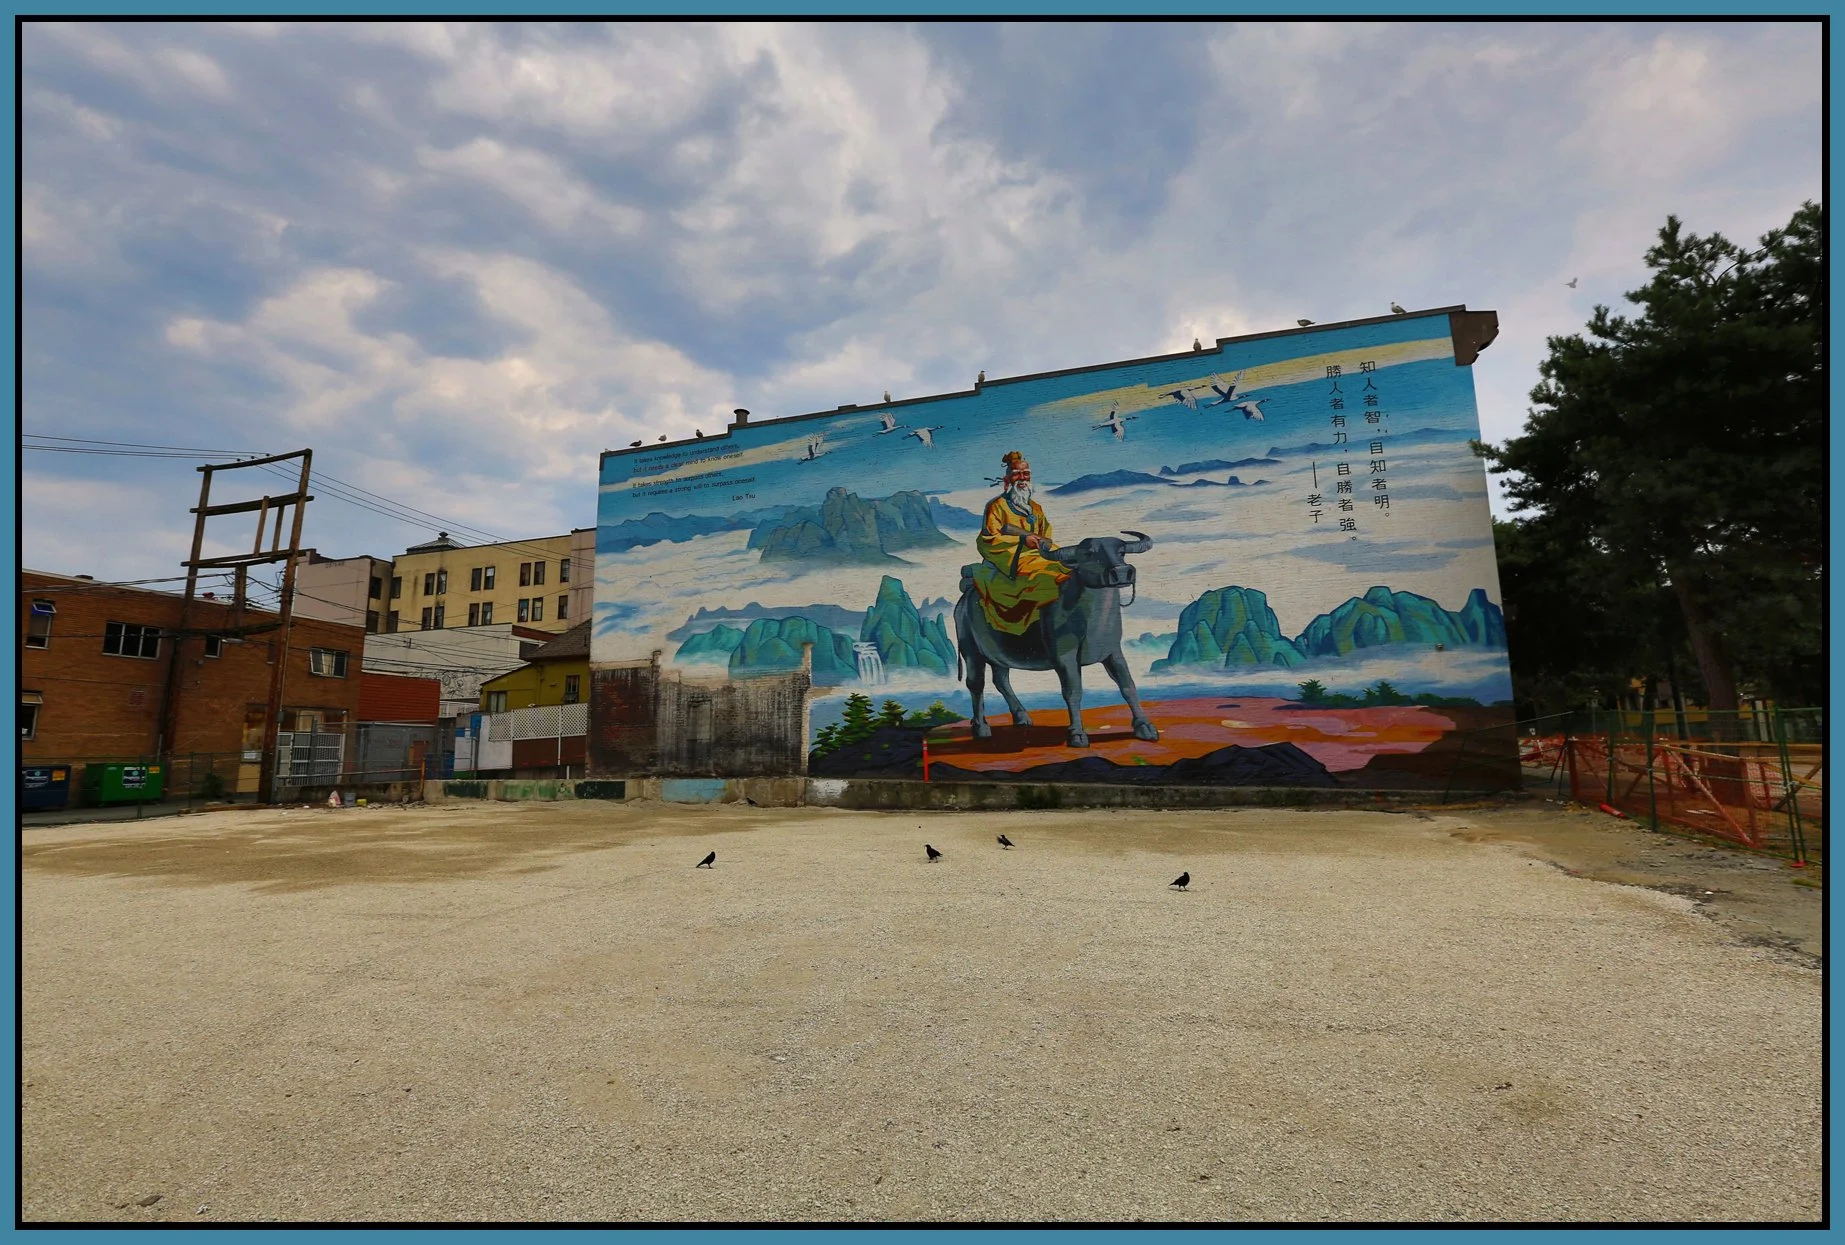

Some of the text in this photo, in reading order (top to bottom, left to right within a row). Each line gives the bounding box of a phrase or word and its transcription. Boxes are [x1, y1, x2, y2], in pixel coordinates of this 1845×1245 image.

[654, 452, 681, 461] knowledge
[690, 446, 720, 456] understand
[647, 488, 668, 496] requires
[711, 479, 733, 488] surpass
[652, 478, 674, 486] strength
